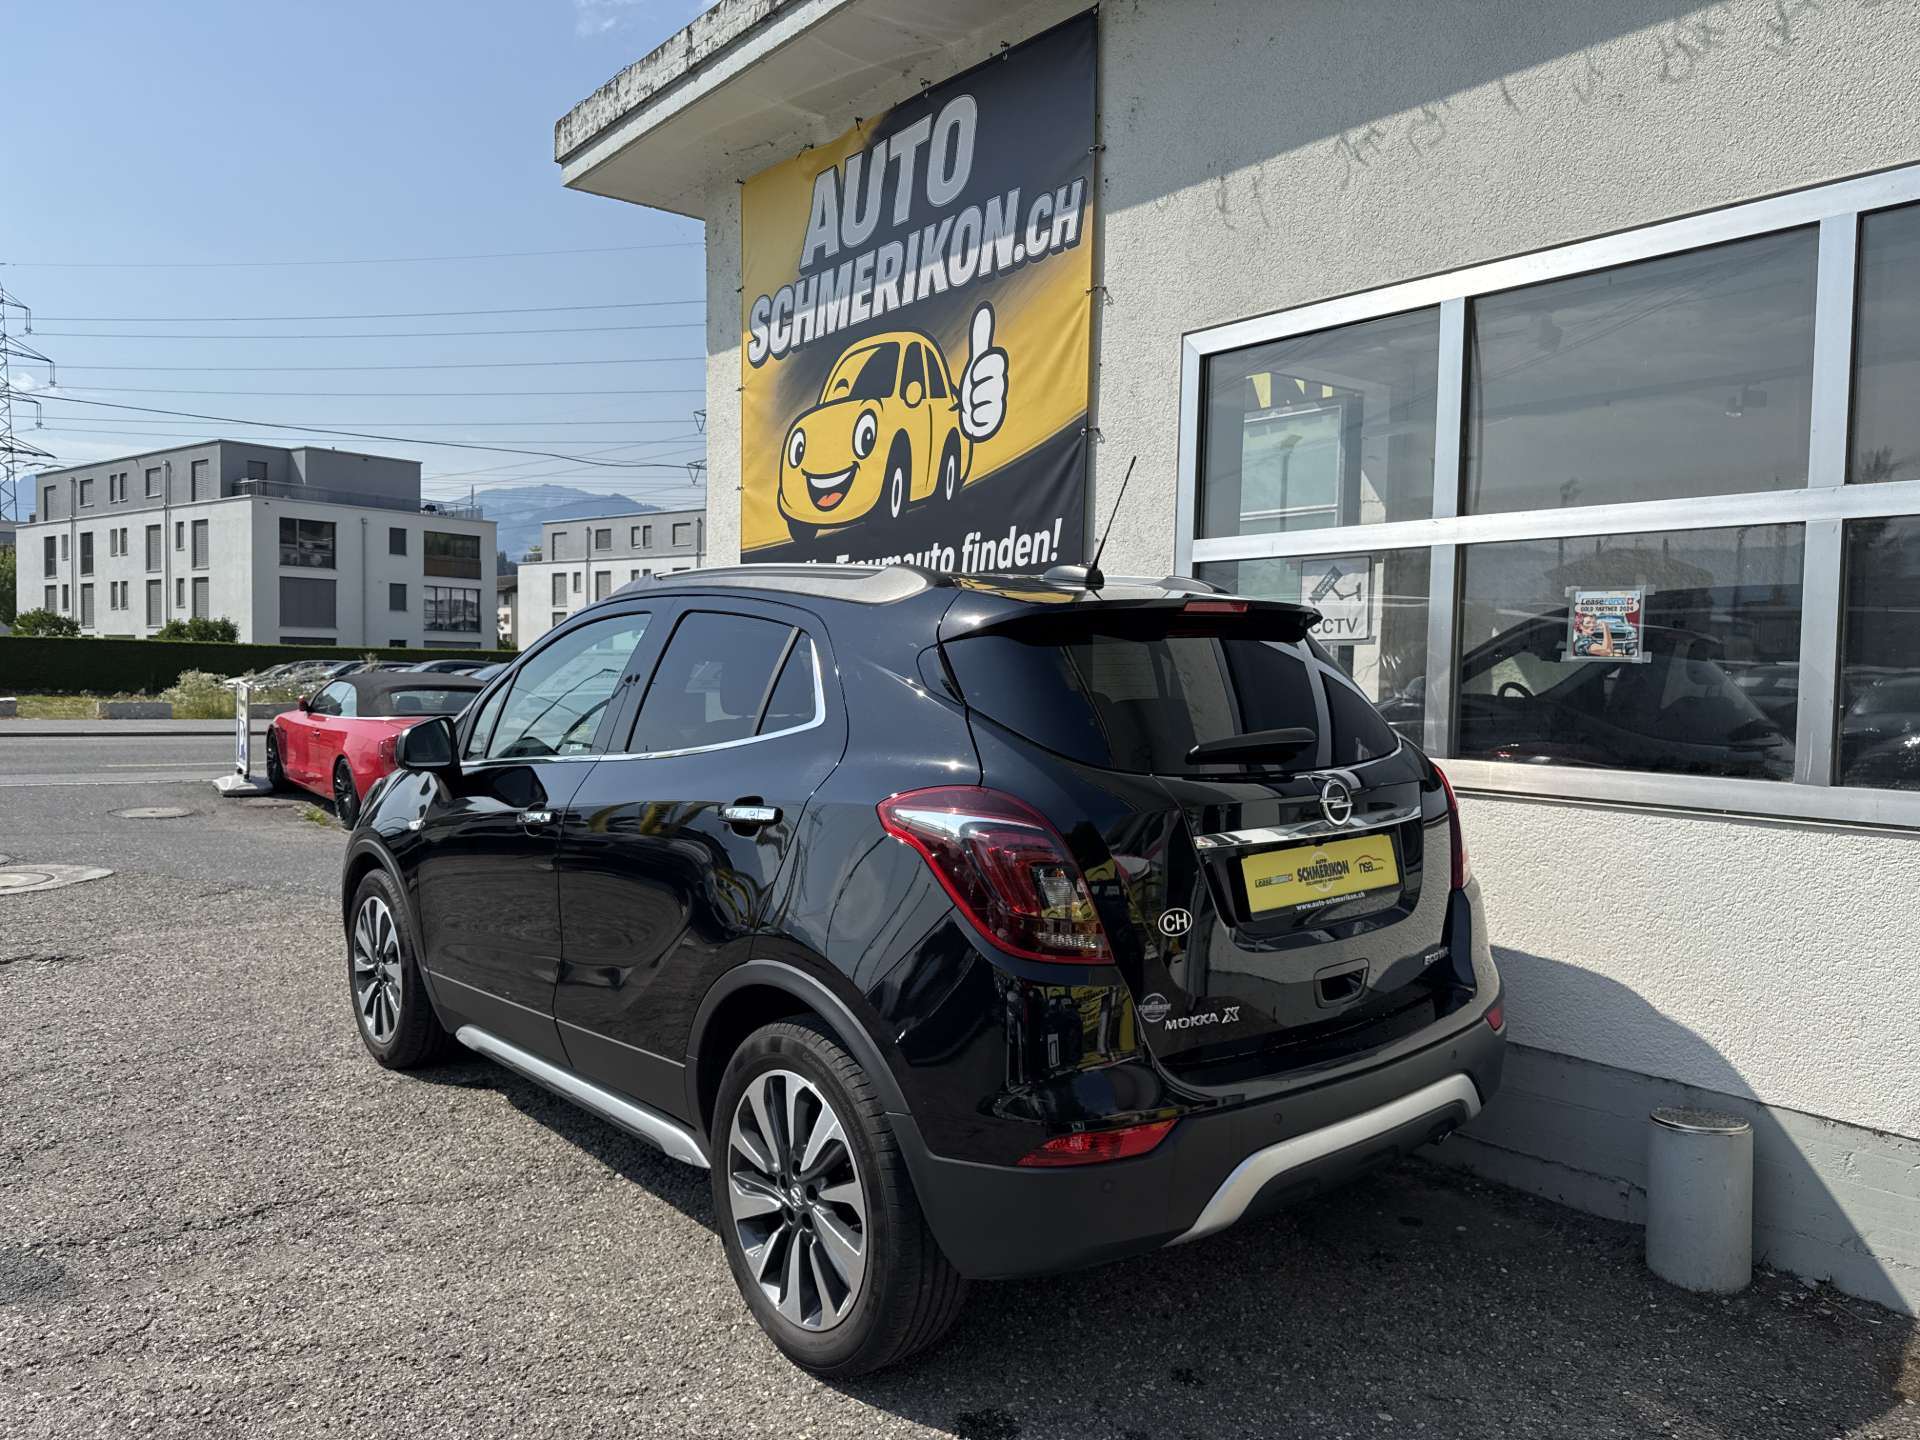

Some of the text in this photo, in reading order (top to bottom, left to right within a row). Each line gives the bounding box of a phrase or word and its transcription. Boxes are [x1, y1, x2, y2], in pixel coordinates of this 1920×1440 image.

[800, 94, 978, 269] AUTO
[747, 178, 1087, 367] SCHMERIKON.CH
[962, 517, 1063, 573] finden!
[1297, 860, 1350, 882] SCHMERIKON
[1163, 913, 1187, 932] CH
[1165, 1006, 1240, 1031] MOKKA X
